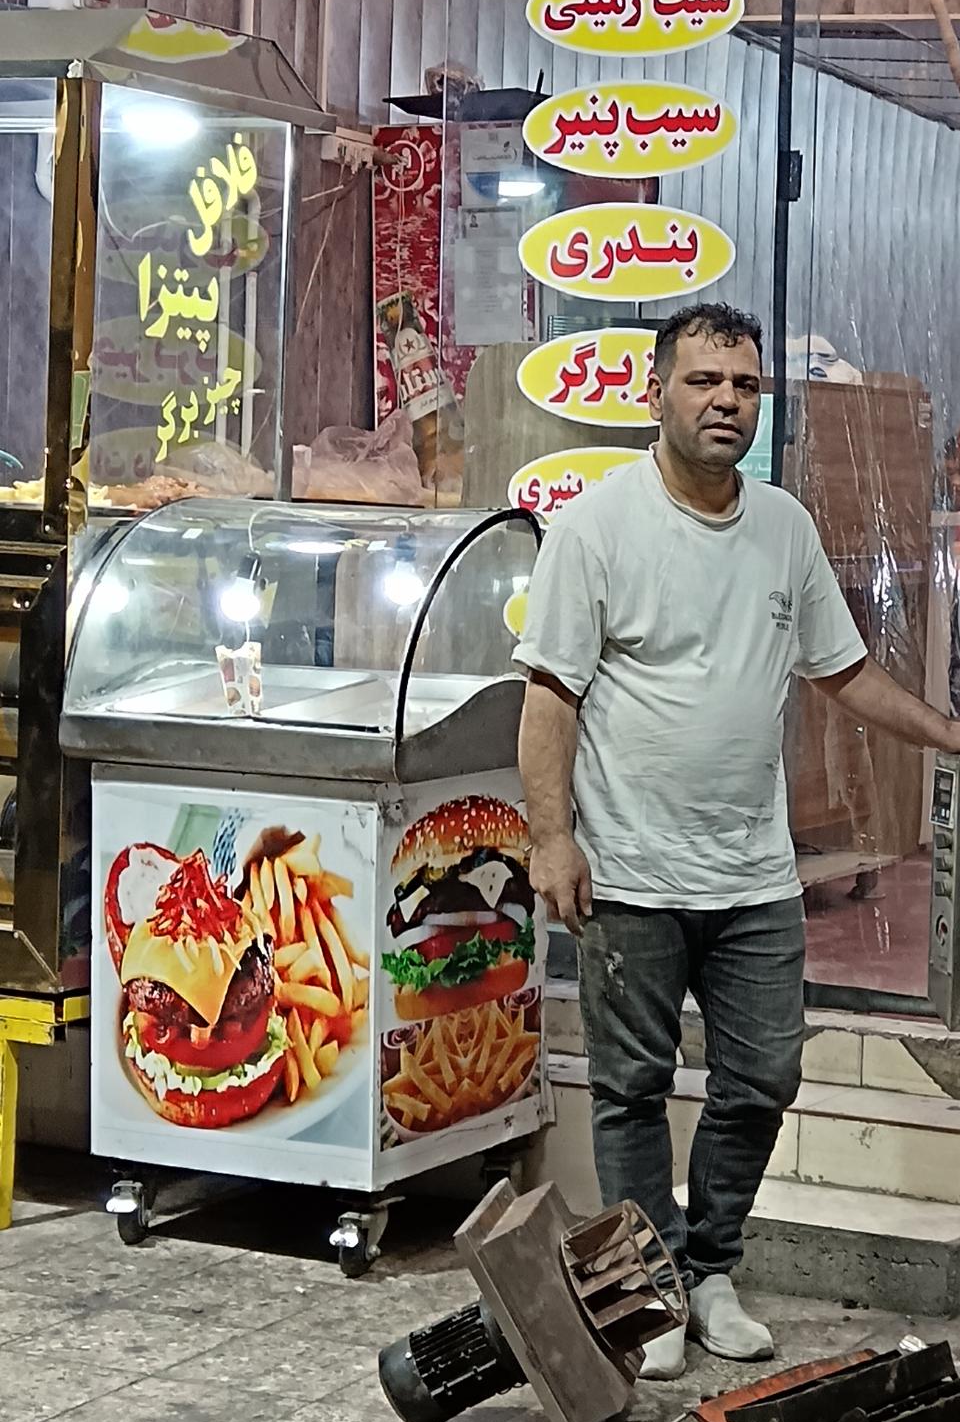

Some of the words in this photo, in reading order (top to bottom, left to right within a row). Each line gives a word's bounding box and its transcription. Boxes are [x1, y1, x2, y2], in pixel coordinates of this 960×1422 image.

[543, 91, 620, 158] پنیر
[627, 99, 722, 151] سیب
[187, 132, 259, 255] فلافل
[549, 221, 699, 280] بندری
[138, 252, 220, 352] پیتزا
[548, 342, 632, 403] برگر
